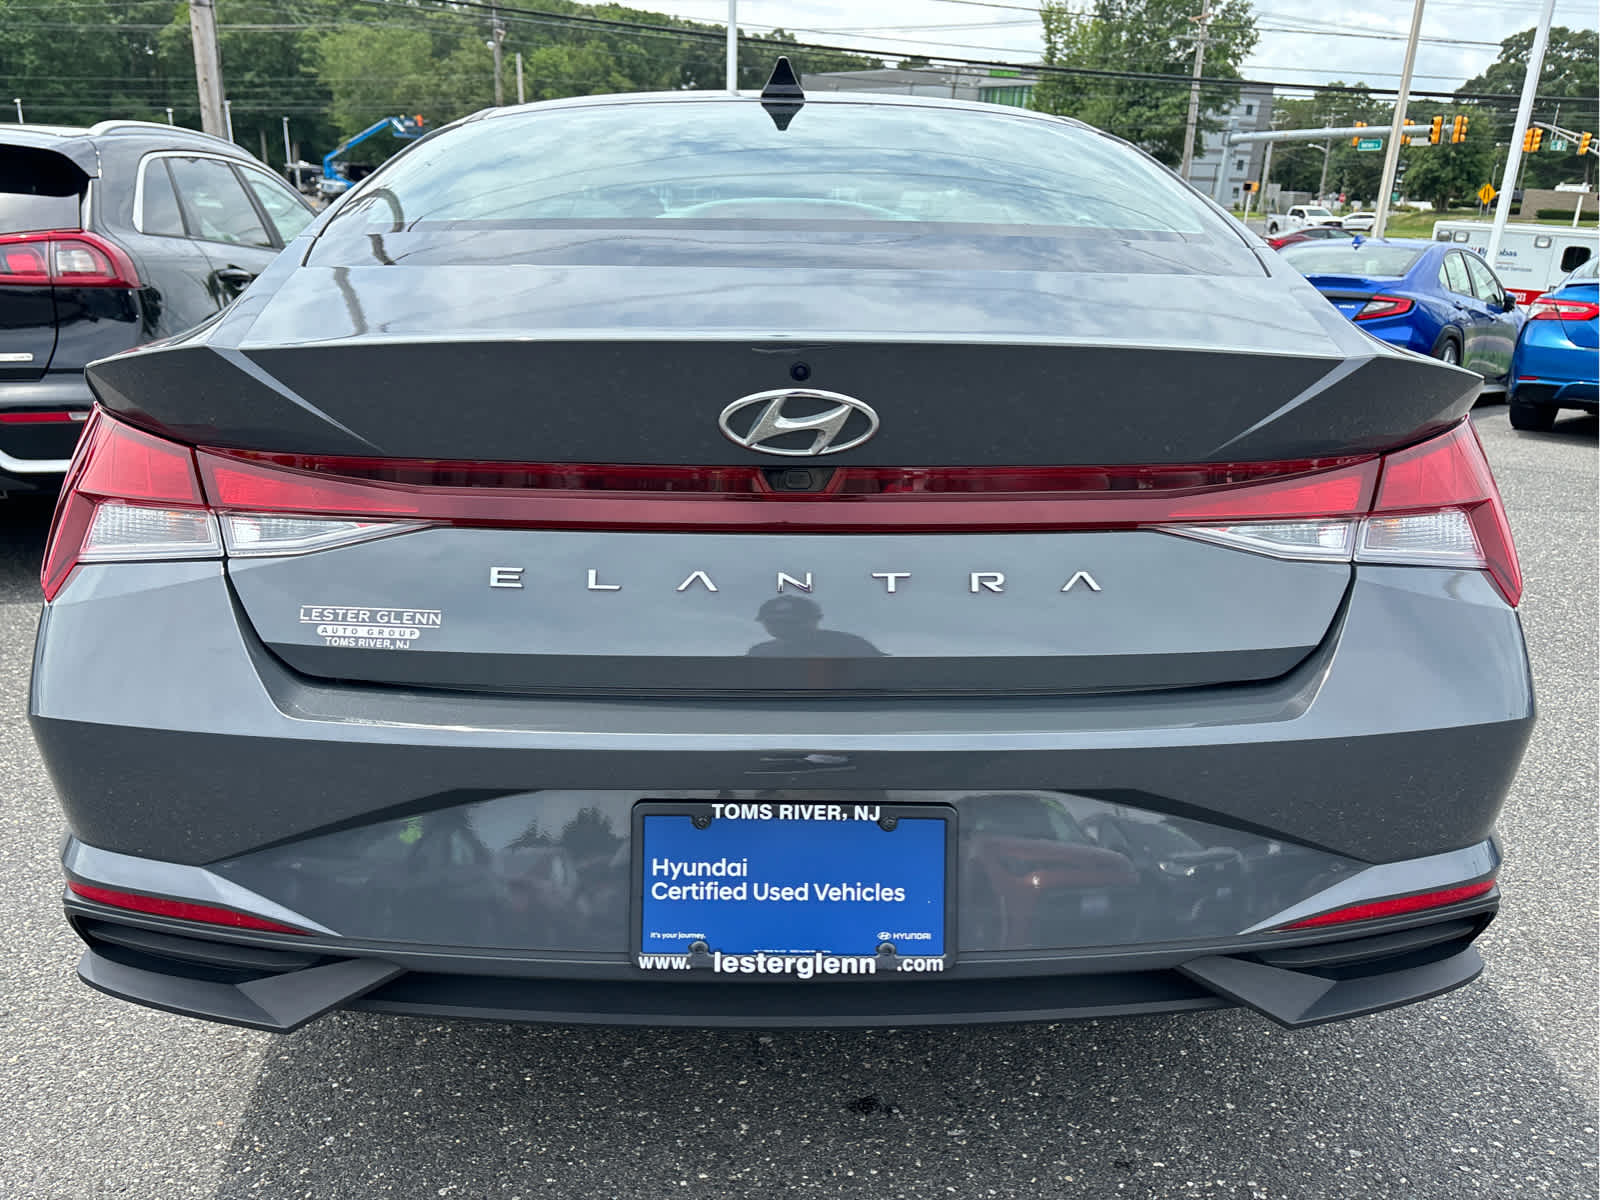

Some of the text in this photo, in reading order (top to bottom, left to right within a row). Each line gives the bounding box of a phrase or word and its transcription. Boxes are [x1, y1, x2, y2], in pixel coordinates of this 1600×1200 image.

[489, 566, 1104, 593] ELANTRA
[299, 608, 442, 625] LESTER GLENN
[320, 626, 417, 637] AUTO GROUP
[325, 637, 356, 646] TOMS
[357, 638, 393, 649] RIVER,
[711, 803, 881, 821] TOMS RIVER, NJ
[652, 858, 748, 880] Hyundai
[651, 881, 906, 902] Certified Used Vehicles
[893, 932, 932, 940] HYUNDAI
[638, 952, 944, 979] www. lesterglenn .com
